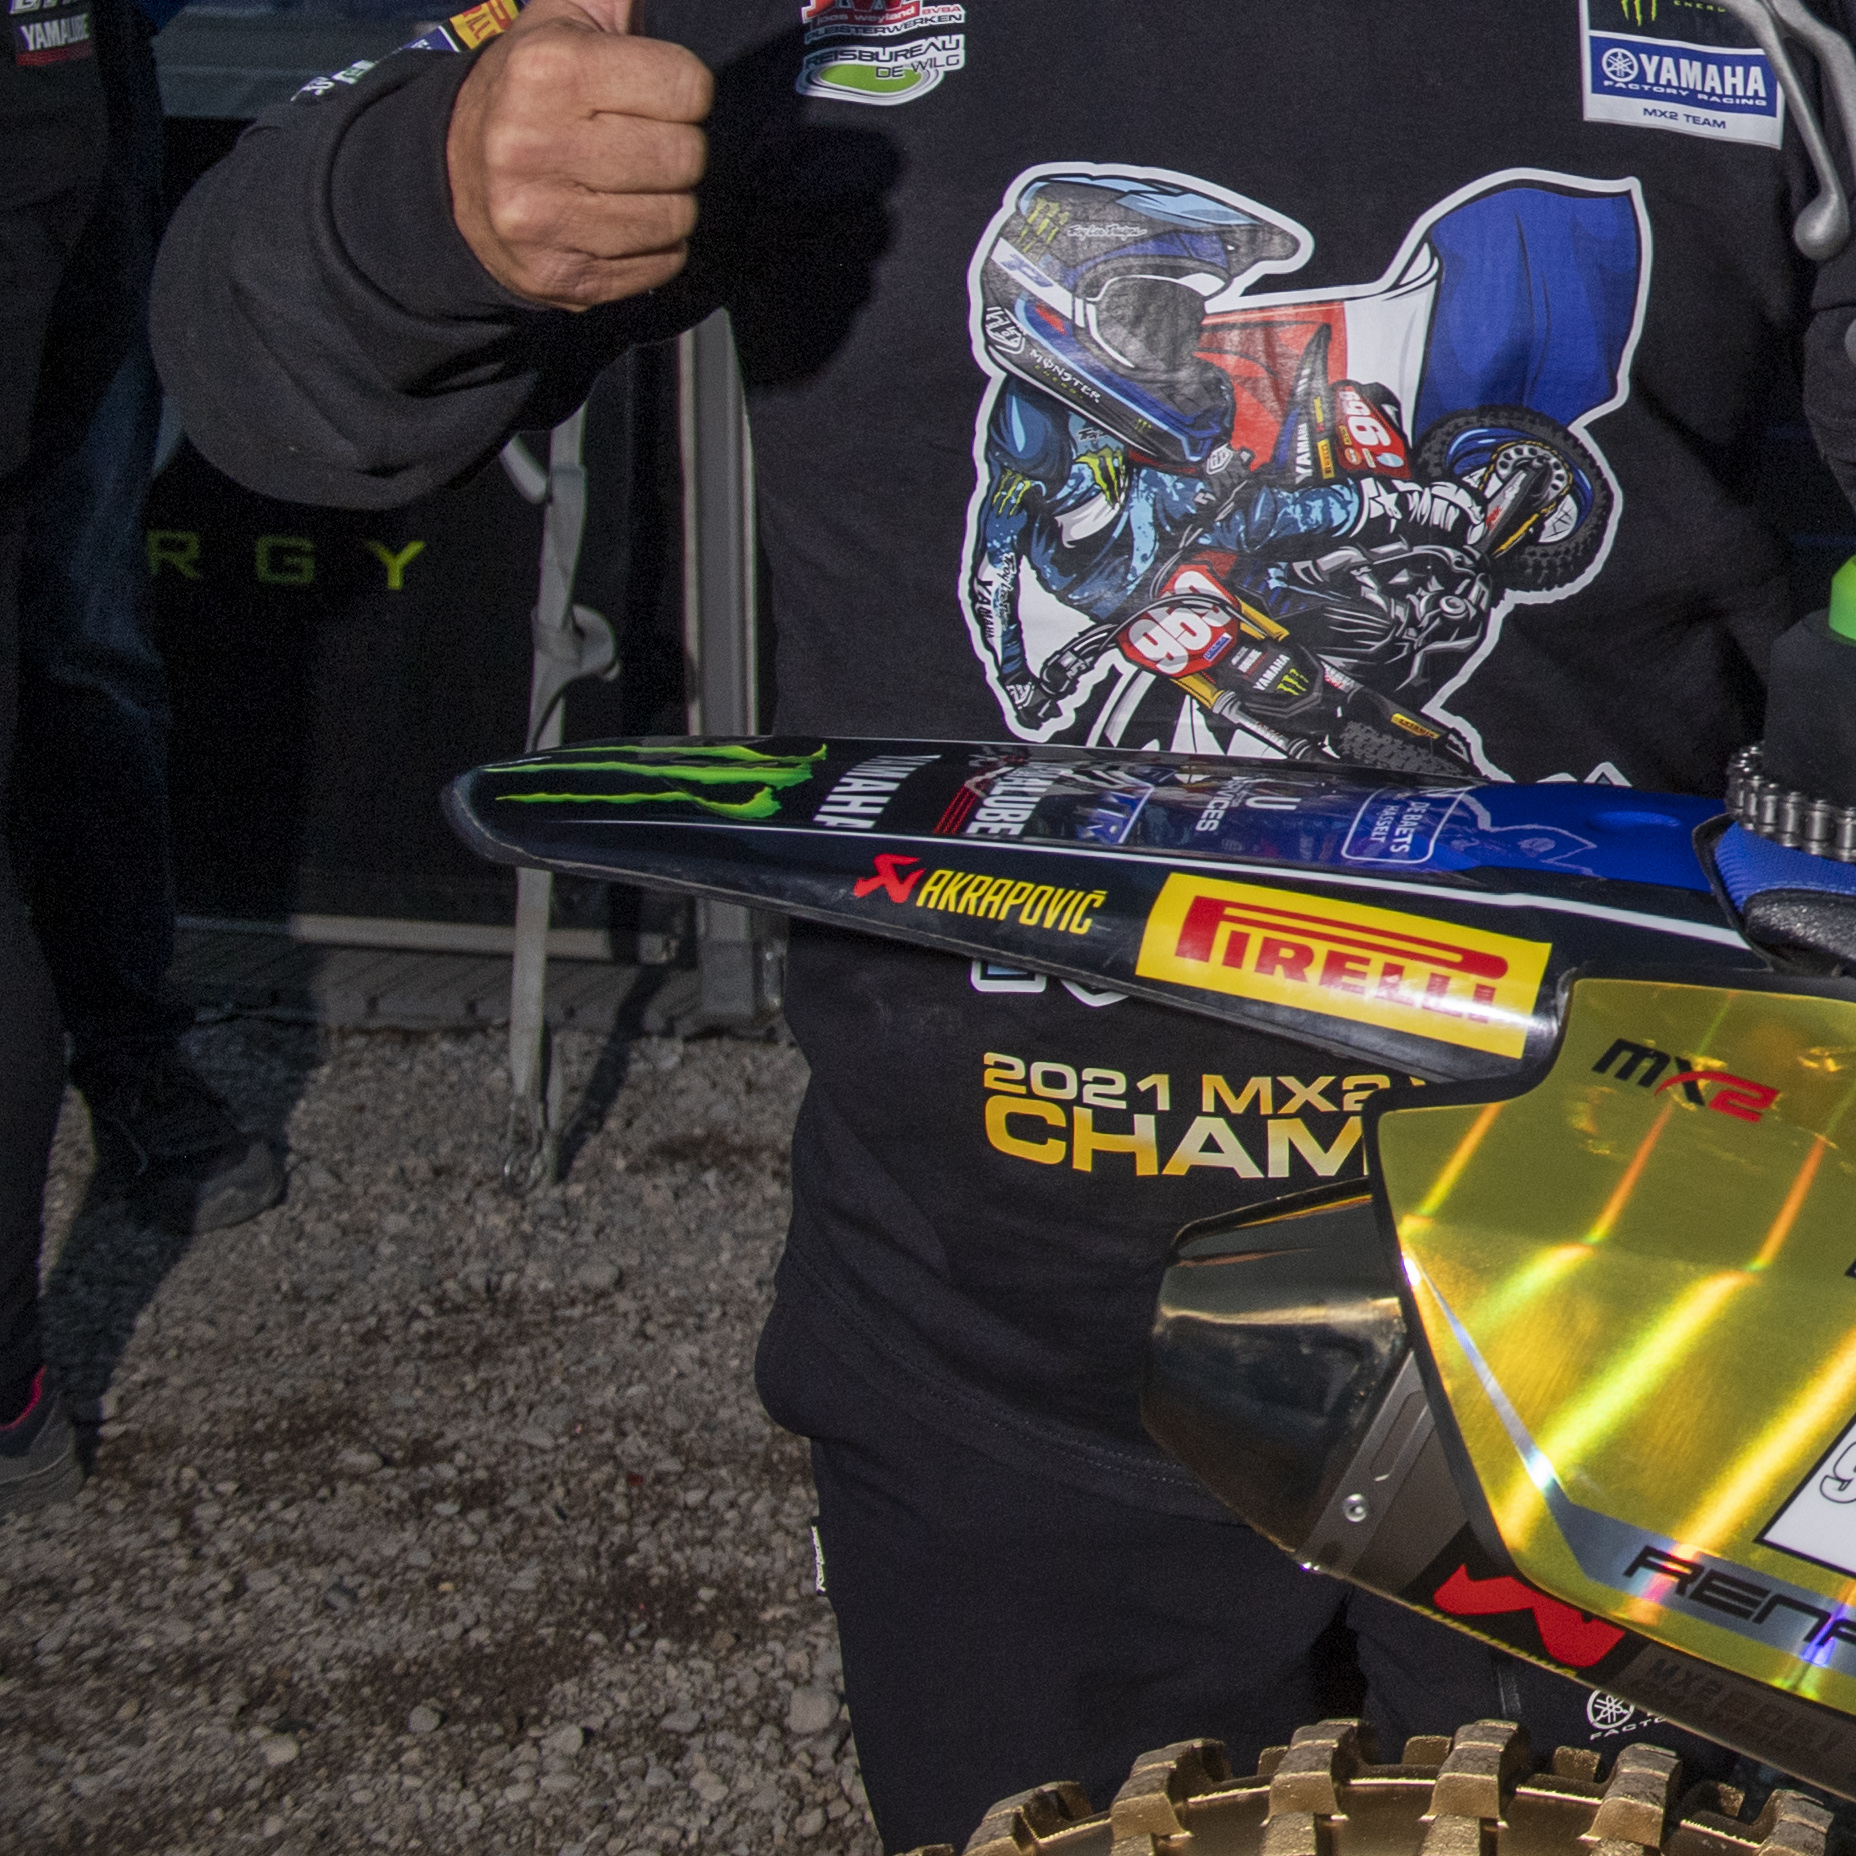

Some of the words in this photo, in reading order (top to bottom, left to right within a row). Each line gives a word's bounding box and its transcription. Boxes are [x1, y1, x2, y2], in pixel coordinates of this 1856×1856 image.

[805, 35, 960, 68] REISBUREAU
[876, 65, 904, 79] DE
[911, 54, 960, 73] WILG
[1603, 80, 1690, 96] FACTORY
[1698, 93, 1767, 107] RACING
[1640, 53, 1767, 97] YAMAHA
[1643, 107, 1678, 121] MX2
[1683, 113, 1727, 129] TEAM
[1029, 348, 1100, 404] MONSTER
[1252, 654, 1290, 691] YAMAHA
[1175, 894, 1509, 1024] PIRELLI
[983, 1051, 1171, 1112] 2021
[1201, 1074, 1390, 1115] MX2
[1591, 1037, 1781, 1124] MX2
